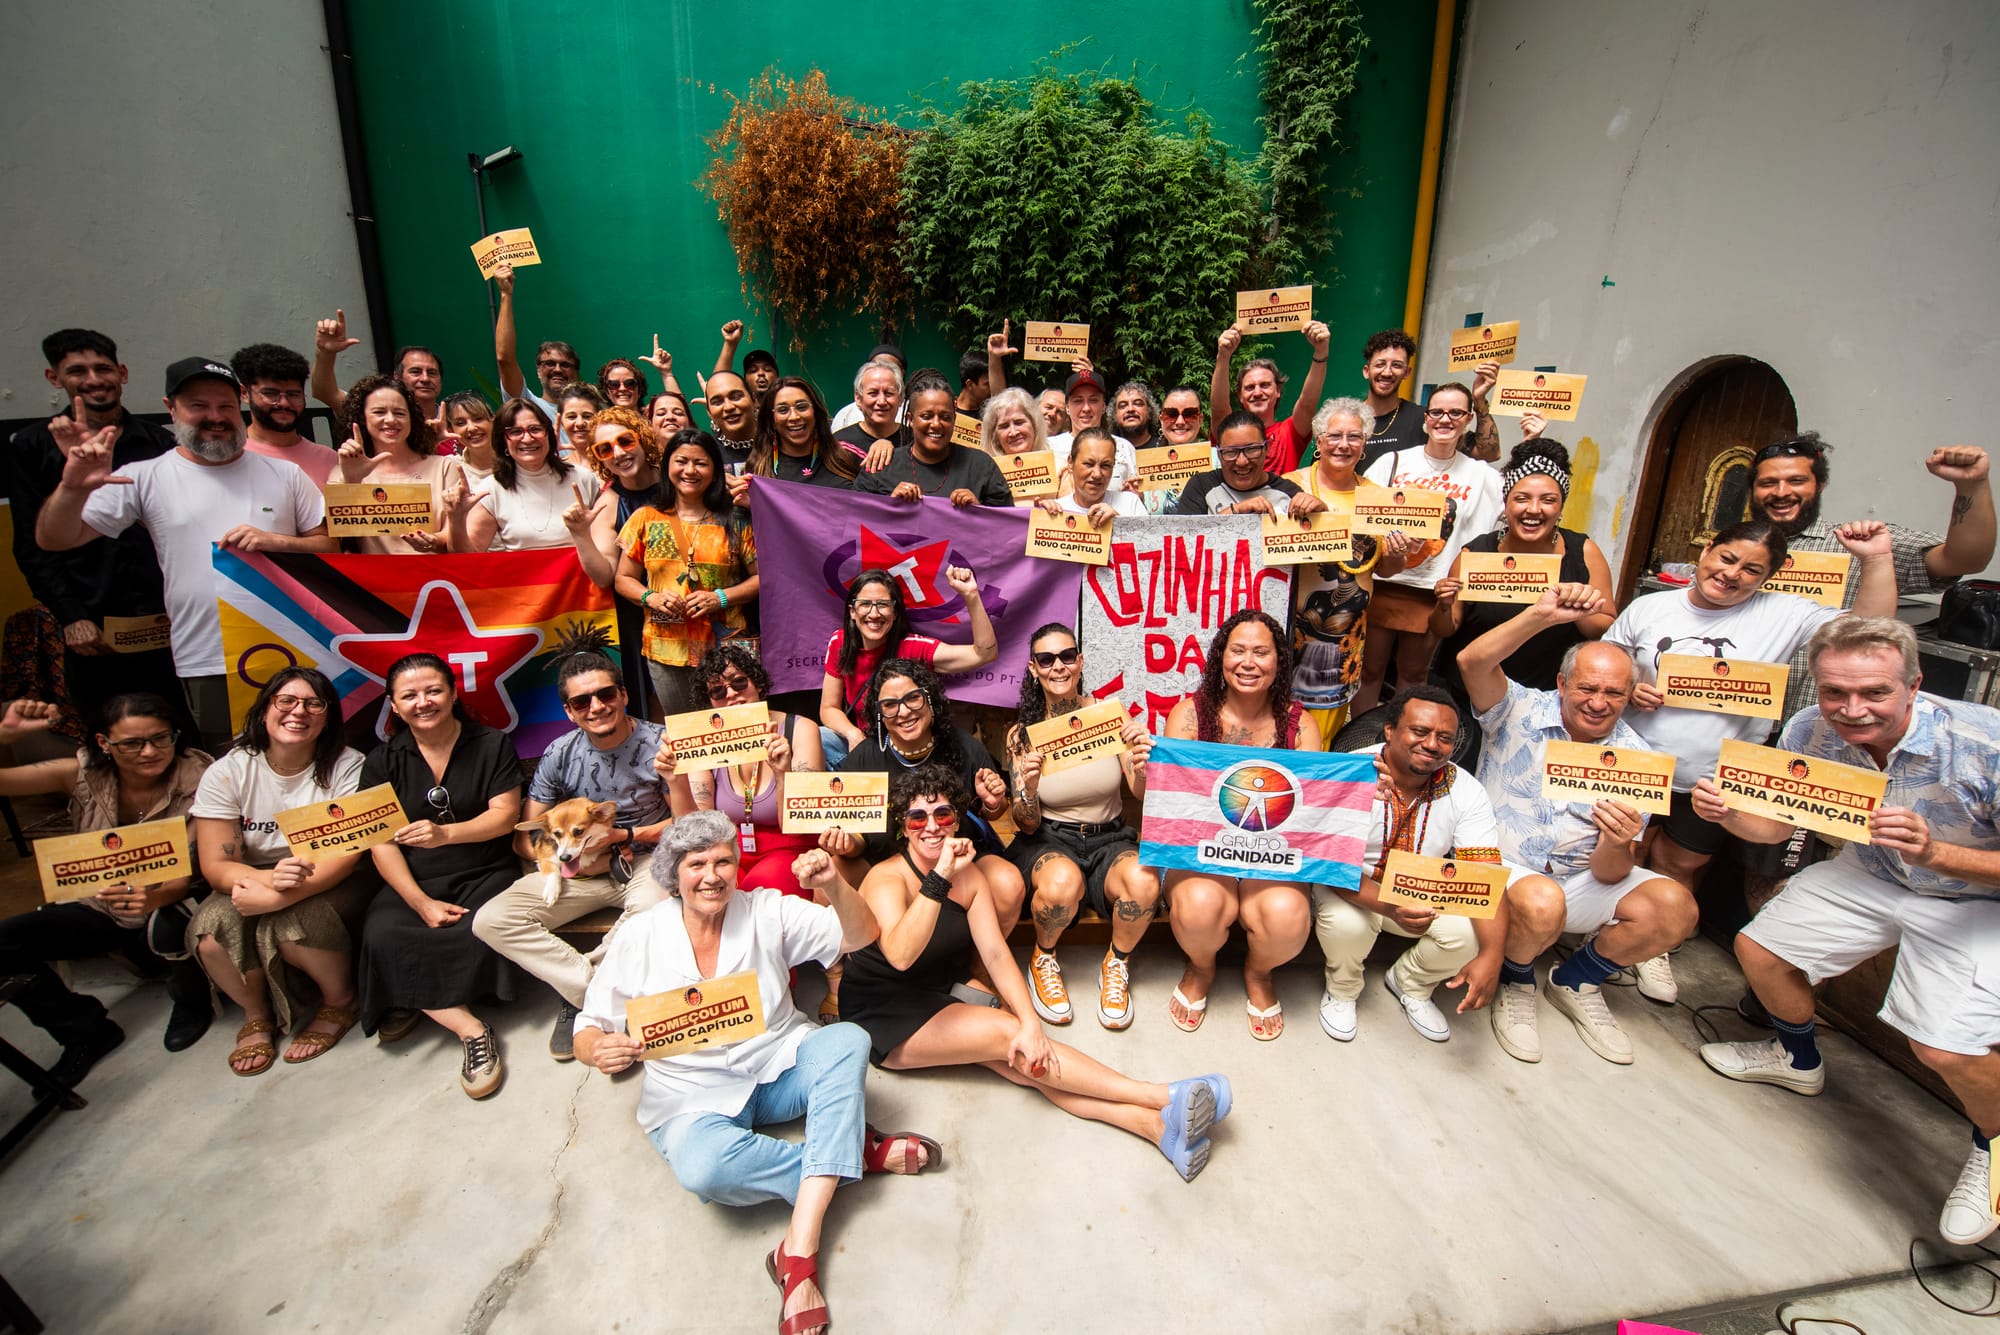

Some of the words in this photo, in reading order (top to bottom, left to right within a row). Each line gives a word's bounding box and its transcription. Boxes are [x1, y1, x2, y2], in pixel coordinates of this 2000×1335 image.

[479, 251, 494, 264] COM
[494, 242, 532, 256] CORAGEM
[483, 258, 498, 270] PARA
[498, 250, 535, 262] AVANÇAR
[1239, 310, 1260, 318] ESSA
[1261, 303, 1309, 315] CAMINHADA
[1248, 317, 1254, 325] É
[1256, 315, 1300, 324] COLETIVA
[1041, 346, 1078, 354] COLETIVA
[1453, 346, 1474, 355] COM
[1475, 338, 1515, 351] CORAGEM
[1453, 354, 1476, 362] PARA
[1478, 348, 1513, 360] AVANÇAR
[1502, 390, 1553, 401] COMEÇOU
[1499, 399, 1524, 407] NOVO
[1526, 400, 1571, 411] CAPÍTULO
[1139, 466, 1160, 474] ESSA
[1160, 458, 1209, 471] CAMINHADA
[1004, 469, 1035, 481] MEÇOU
[1014, 477, 1051, 488] CAPÍTULO
[1150, 473, 1155, 481] É
[332, 507, 363, 516] COM
[366, 504, 428, 514] CORAGEM
[1356, 507, 1381, 515] ESSA
[1383, 508, 1439, 517] CAMINHADA
[333, 517, 368, 525] PARA
[371, 516, 430, 527] AVANÇAR
[1366, 515, 1373, 524] É
[1375, 518, 1426, 528] COLETIVA
[1036, 530, 1085, 543] COMEÇOU
[1266, 536, 1295, 546] COM
[1295, 530, 1346, 543] CORAGEM
[1034, 540, 1059, 549] NOVO
[1060, 542, 1102, 554] CAPÍTULO
[1267, 546, 1295, 554] PARA
[1297, 543, 1348, 554] AVANÇAR
[887, 556, 926, 603] T
[1469, 573, 1524, 583] COMEÇOU
[1527, 573, 1546, 582] UM
[1772, 572, 1841, 584] AMINHADA
[1762, 582, 1823, 595] OLETIVA
[115, 636, 148, 646] NOVO
[1145, 634, 1207, 674] DA
[448, 651, 488, 692] T
[975, 671, 994, 682] DO
[1000, 674, 1021, 685] PT-
[1669, 677, 1743, 692] COMEÇOU
[1744, 682, 1768, 693] UM
[1667, 688, 1704, 699] NOVO
[1705, 692, 1772, 706] CAPÍTULO
[674, 737, 704, 750] COM
[704, 724, 765, 745] CORAGEM
[1037, 739, 1063, 754] ESSA
[1064, 718, 1123, 744] CAMINHADA
[676, 749, 708, 761] PARA
[1052, 750, 1060, 761] É
[1062, 735, 1116, 757] COLETIVA
[1550, 765, 1588, 778] COM
[1590, 769, 1664, 786] CORAGEM
[1549, 777, 1587, 790] PARA
[1591, 782, 1664, 801] AVANÇAR
[1723, 768, 1766, 788] COM
[1768, 779, 1870, 809] CORAGEM
[789, 799, 820, 809] COM
[820, 796, 882, 807] CORAGEM
[1720, 780, 1769, 800] PARA
[1772, 794, 1867, 827] AVANÇAR
[290, 823, 323, 844] ESSA
[323, 804, 398, 835] CAMINHADA
[789, 811, 822, 820] PARA
[825, 811, 883, 822] AVANÇAR
[310, 836, 320, 850] É
[321, 822, 389, 847] COLETIVA
[1221, 834, 1281, 850] GRUPO
[55, 850, 142, 876] COMEÇOU
[143, 841, 171, 858] UM
[1204, 846, 1295, 865] DIGNIDADE
[56, 873, 100, 887] NOVO
[103, 857, 178, 881] CAPÍTULO
[1396, 876, 1466, 894] COMEÇOU
[1467, 882, 1488, 893] UM
[1392, 887, 1429, 901] NOVO
[1430, 894, 1490, 907] CAPÍTULO
[643, 1005, 723, 1039] COMEÇOU
[725, 998, 746, 1013] UM
[645, 1033, 685, 1050] NOVO
[687, 1014, 753, 1038] CAPÍTULO
